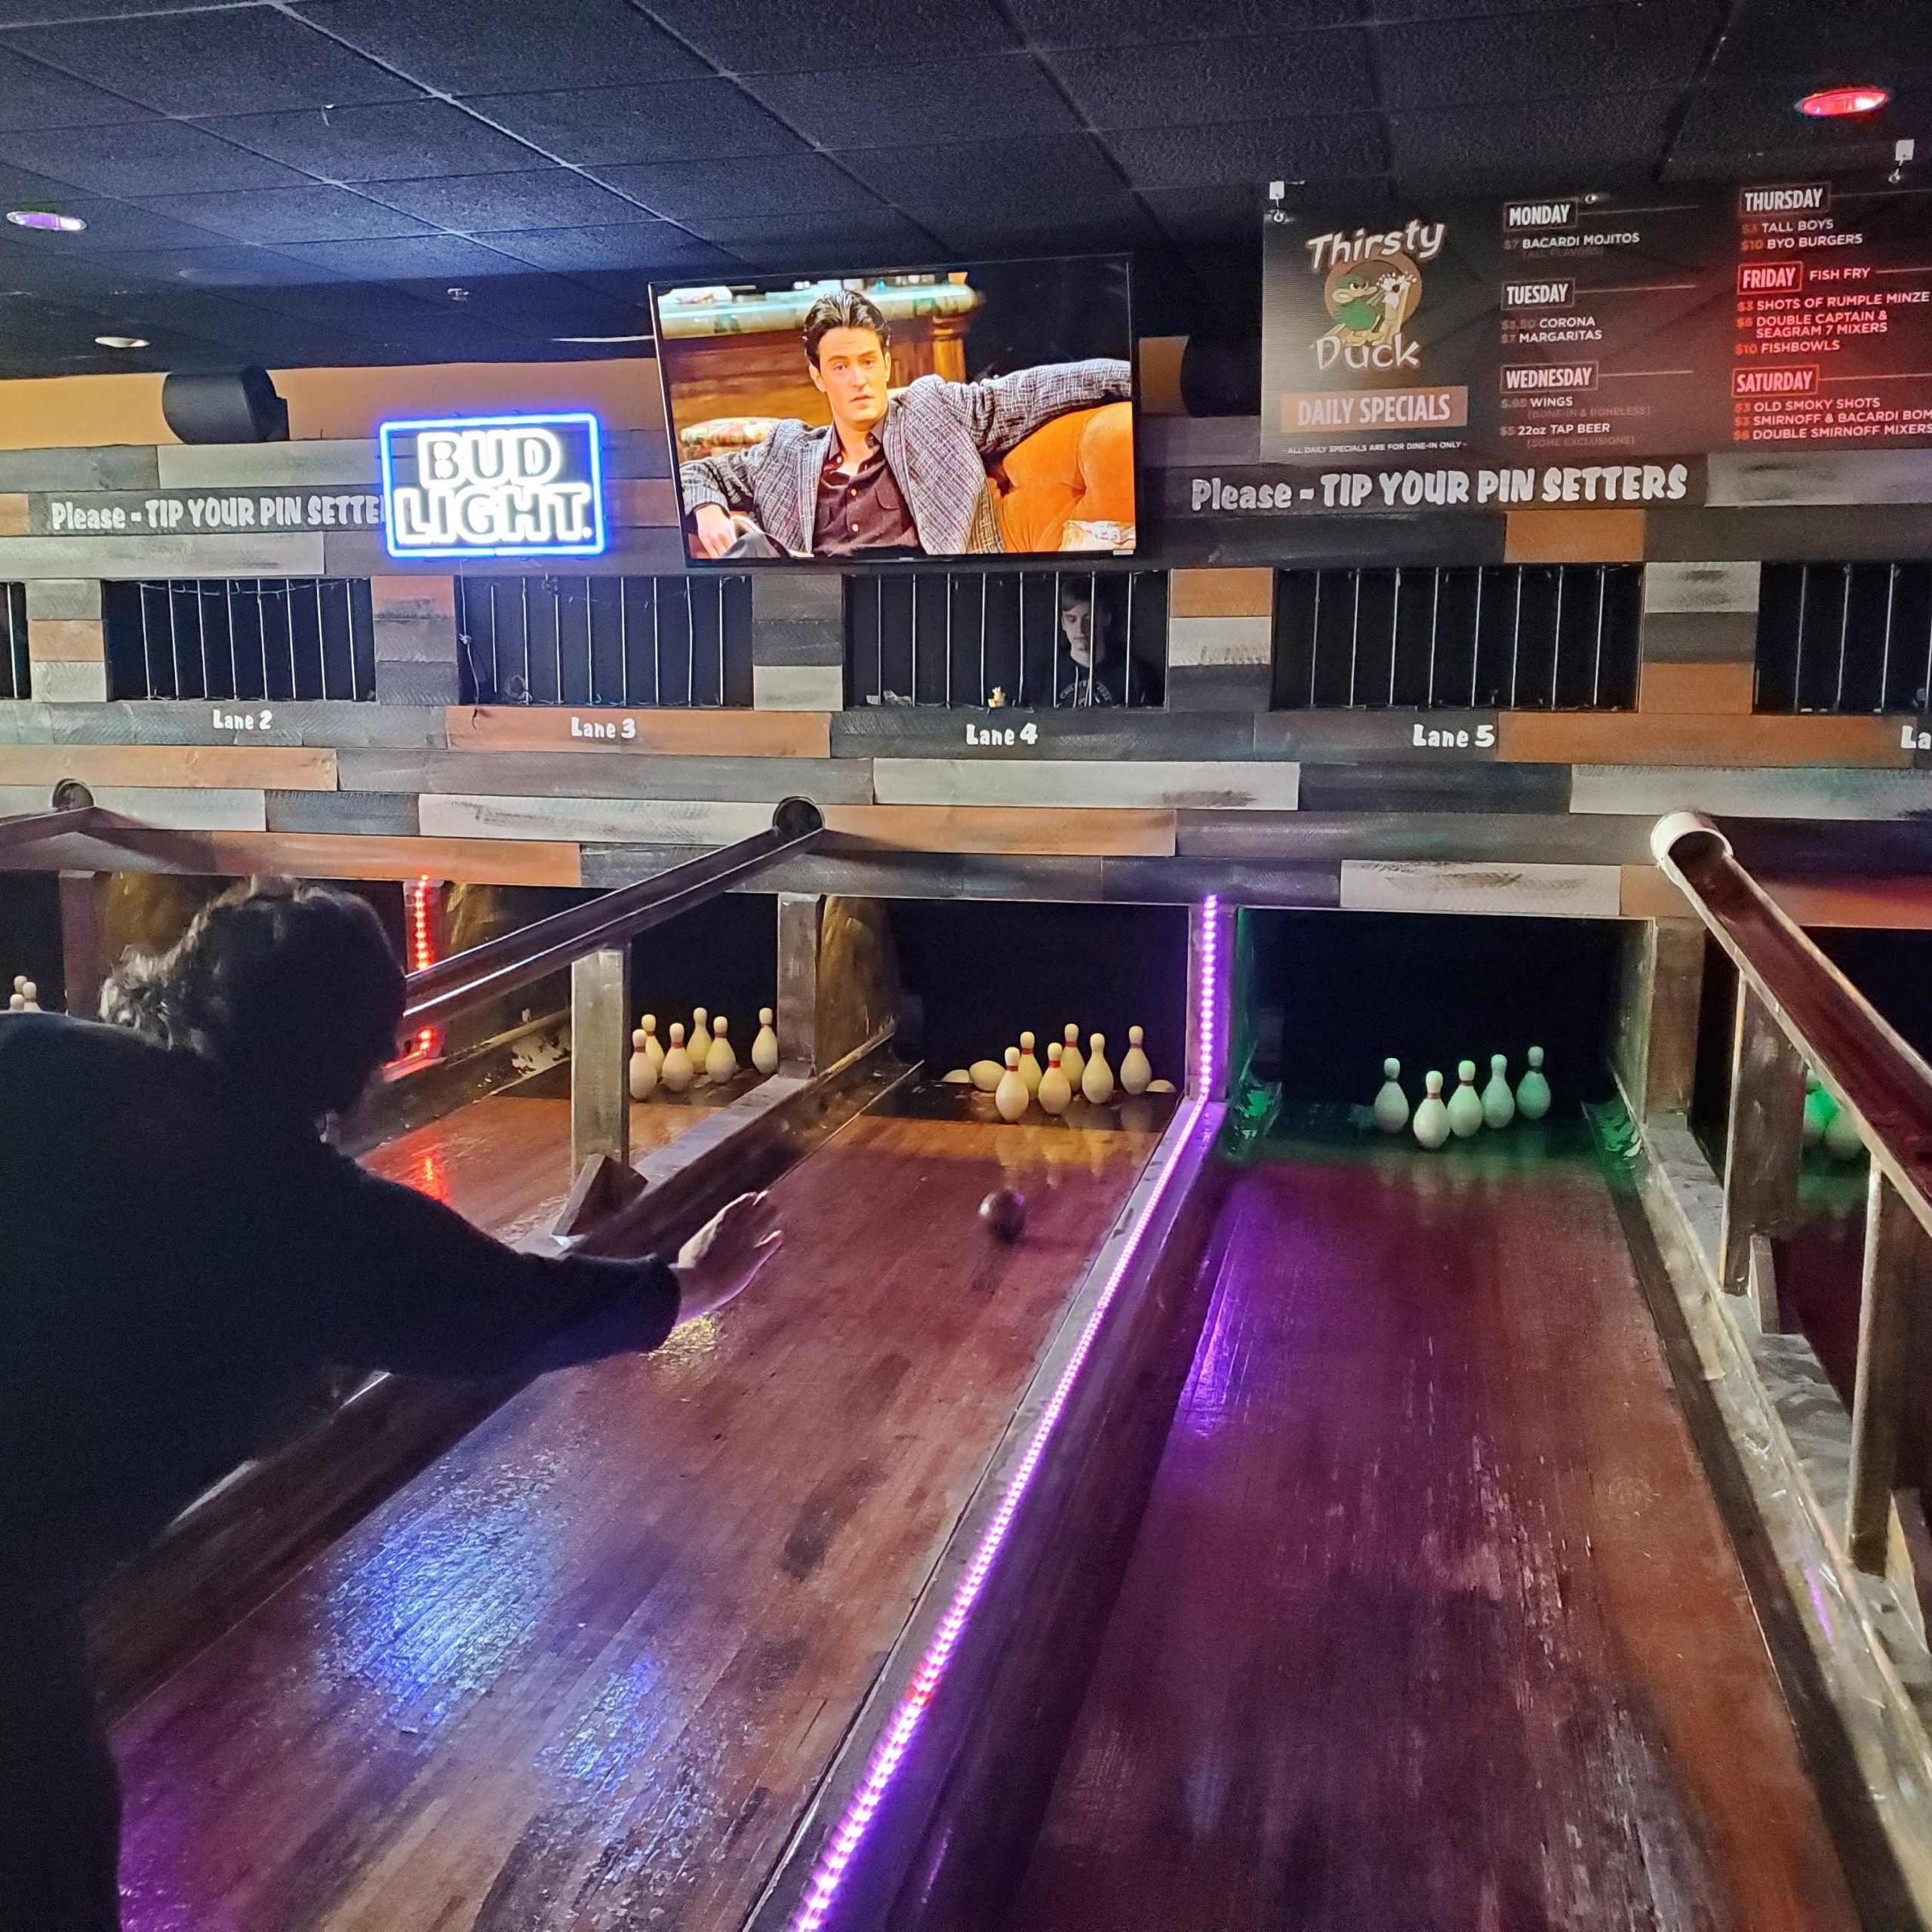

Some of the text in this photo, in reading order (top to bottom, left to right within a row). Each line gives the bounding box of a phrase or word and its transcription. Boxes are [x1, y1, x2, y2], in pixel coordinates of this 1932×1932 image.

[1744, 188, 1823, 212] THURSDAY
[1509, 205, 1571, 226] MONDAY
[1761, 222, 1794, 233] TALL
[1798, 219, 1834, 231] BOYS
[1306, 218, 1445, 269] Thirsty
[1522, 235, 1580, 249] BACARDI
[1583, 232, 1641, 246] MOJITOS
[1740, 234, 1863, 251] $10 BYO BURGERS
[1743, 267, 1871, 289] FRIDAY FISH FRY
[1507, 284, 1569, 305] TUESDAY
[1737, 291, 1930, 312] $3 SHOTS OF RUMPLE MINZE
[1540, 316, 1595, 328] CORONA
[1756, 314, 1812, 328] DOUBLE
[1815, 310, 1875, 325] CAPTAIN
[1878, 310, 1888, 321] &
[1519, 330, 1603, 343] MARGARITAS
[1756, 322, 1888, 339] SEAGRAM 7 MIXERS
[1315, 332, 1420, 371] Duck
[1735, 340, 1841, 355] $10 FISHBOWLS
[1506, 367, 1593, 389] WEDNESDAY
[1737, 371, 1814, 392] SATURDAY
[1298, 393, 1451, 426] DAILY SPECIALS
[1530, 396, 1574, 408] WINGS
[1754, 400, 1782, 413] OLD
[1785, 398, 1834, 412] SMOKY
[1836, 397, 1881, 410] SHOTS
[1753, 413, 1822, 426] SMIRNOFF
[1824, 413, 1834, 423] &
[1837, 410, 1899, 423] BACARDI
[1518, 425, 1546, 435] 22oz
[1549, 424, 1574, 435] TAP
[1577, 423, 1611, 434] BEER
[1753, 427, 1807, 440] DOUBLE
[1810, 425, 1881, 438] SMIRNOFF
[1884, 423, 1932, 435] MIXERS
[1304, 445, 1327, 454] DAILY
[1329, 445, 1367, 453] SPECIALS
[1387, 442, 1405, 451] FOR
[1407, 441, 1438, 450] DINE-IN
[1439, 441, 1461, 449] ONLY
[417, 428, 561, 489] BUD
[1191, 478, 1292, 511] Please
[1321, 473, 1373, 509] TIP
[1378, 469, 1470, 506] YOUR
[1477, 467, 1535, 503] PIN
[1541, 463, 1688, 503] SETTERS
[51, 502, 125, 531] Please
[145, 500, 183, 528] TIP
[186, 497, 255, 528] YOUR
[259, 497, 303, 528] PIN
[212, 709, 272, 731] Lane 2
[571, 717, 637, 739] Lane 3
[965, 722, 1038, 746] Lane 4
[1413, 723, 1495, 748] Lane 5
[1900, 724, 1932, 750] La
